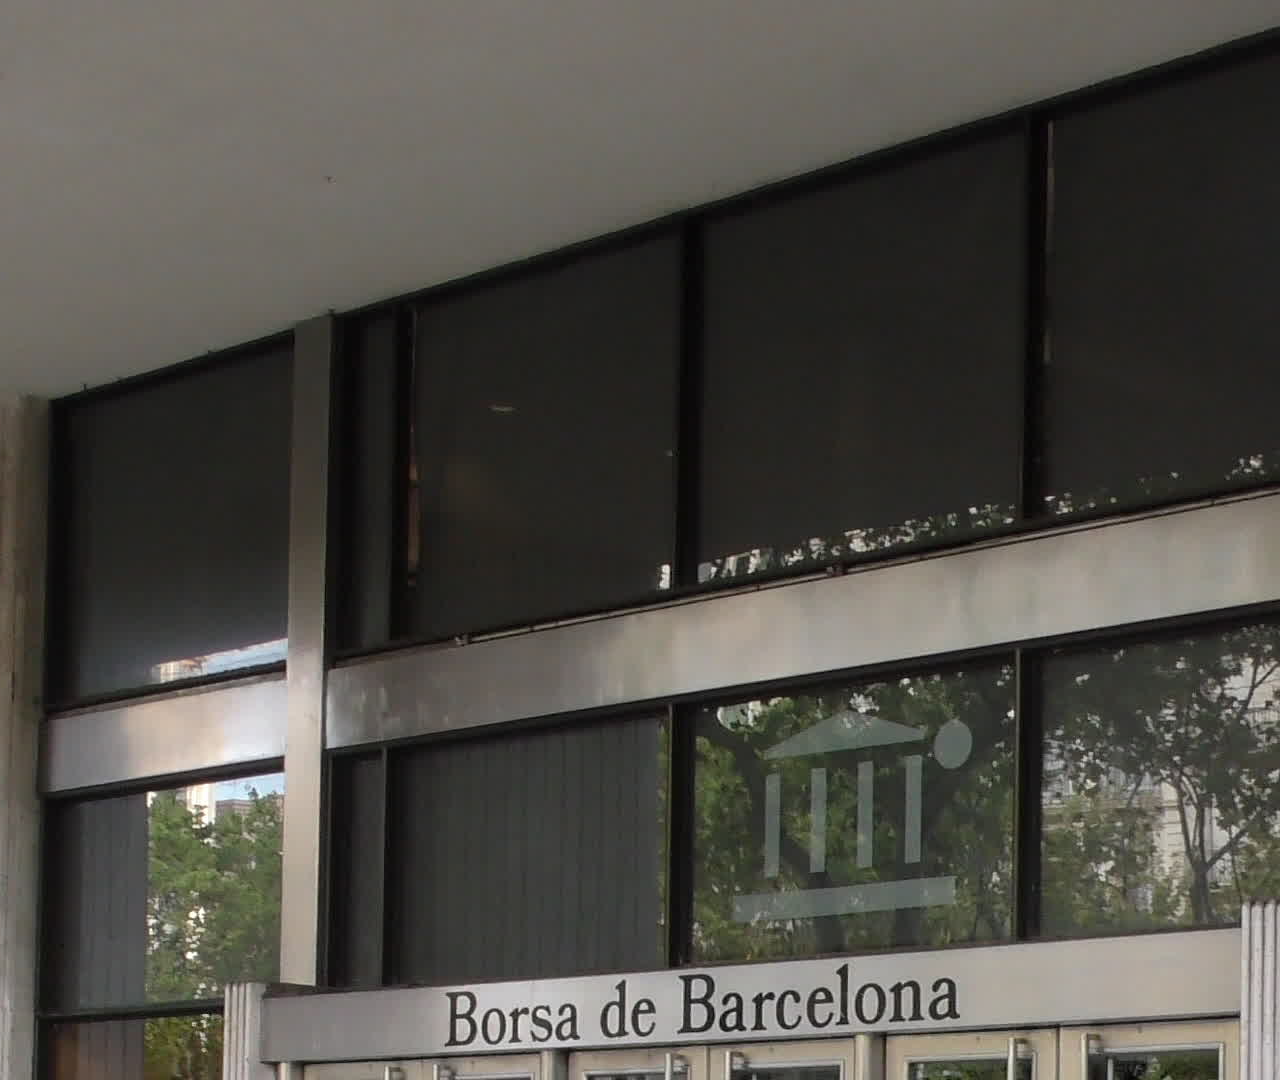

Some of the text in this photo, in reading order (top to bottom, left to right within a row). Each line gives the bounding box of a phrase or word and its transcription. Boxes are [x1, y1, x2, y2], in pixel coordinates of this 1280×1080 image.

[444, 963, 961, 1048] Borsa de Barcelona
